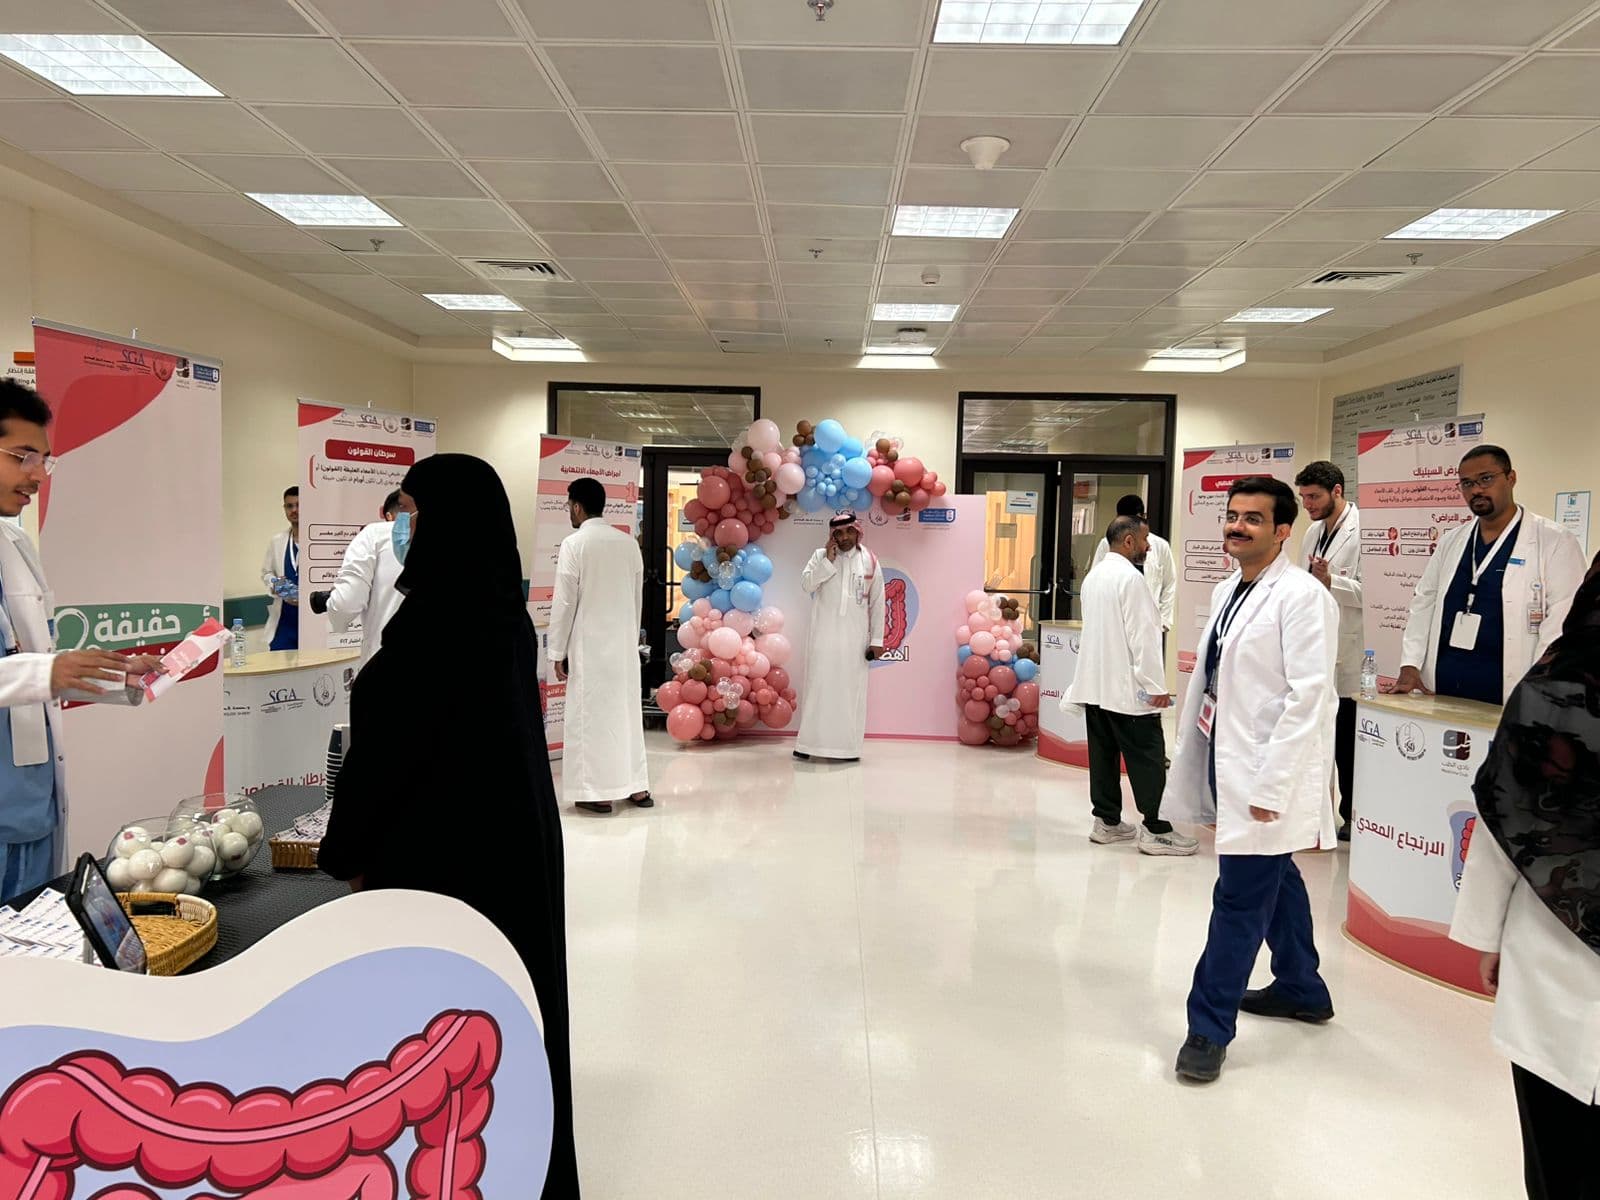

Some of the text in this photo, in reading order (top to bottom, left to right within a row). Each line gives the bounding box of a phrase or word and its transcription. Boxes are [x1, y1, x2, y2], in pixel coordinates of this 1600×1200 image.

[122, 349, 145, 364] SGA
[361, 414, 378, 425] SGA
[1407, 429, 1422, 440] SGA
[347, 446, 396, 459] سرطان القولون
[585, 444, 598, 453] SGA
[1228, 451, 1242, 460] SGA
[1413, 466, 1443, 479] السيلياك
[94, 608, 181, 647] حقيقة
[1047, 634, 1060, 644] SGA
[269, 688, 297, 703] SGA
[1361, 718, 1380, 737] SGA
[298, 772, 326, 786] رطان
[1357, 817, 1445, 856] الارتجاع المعدي
